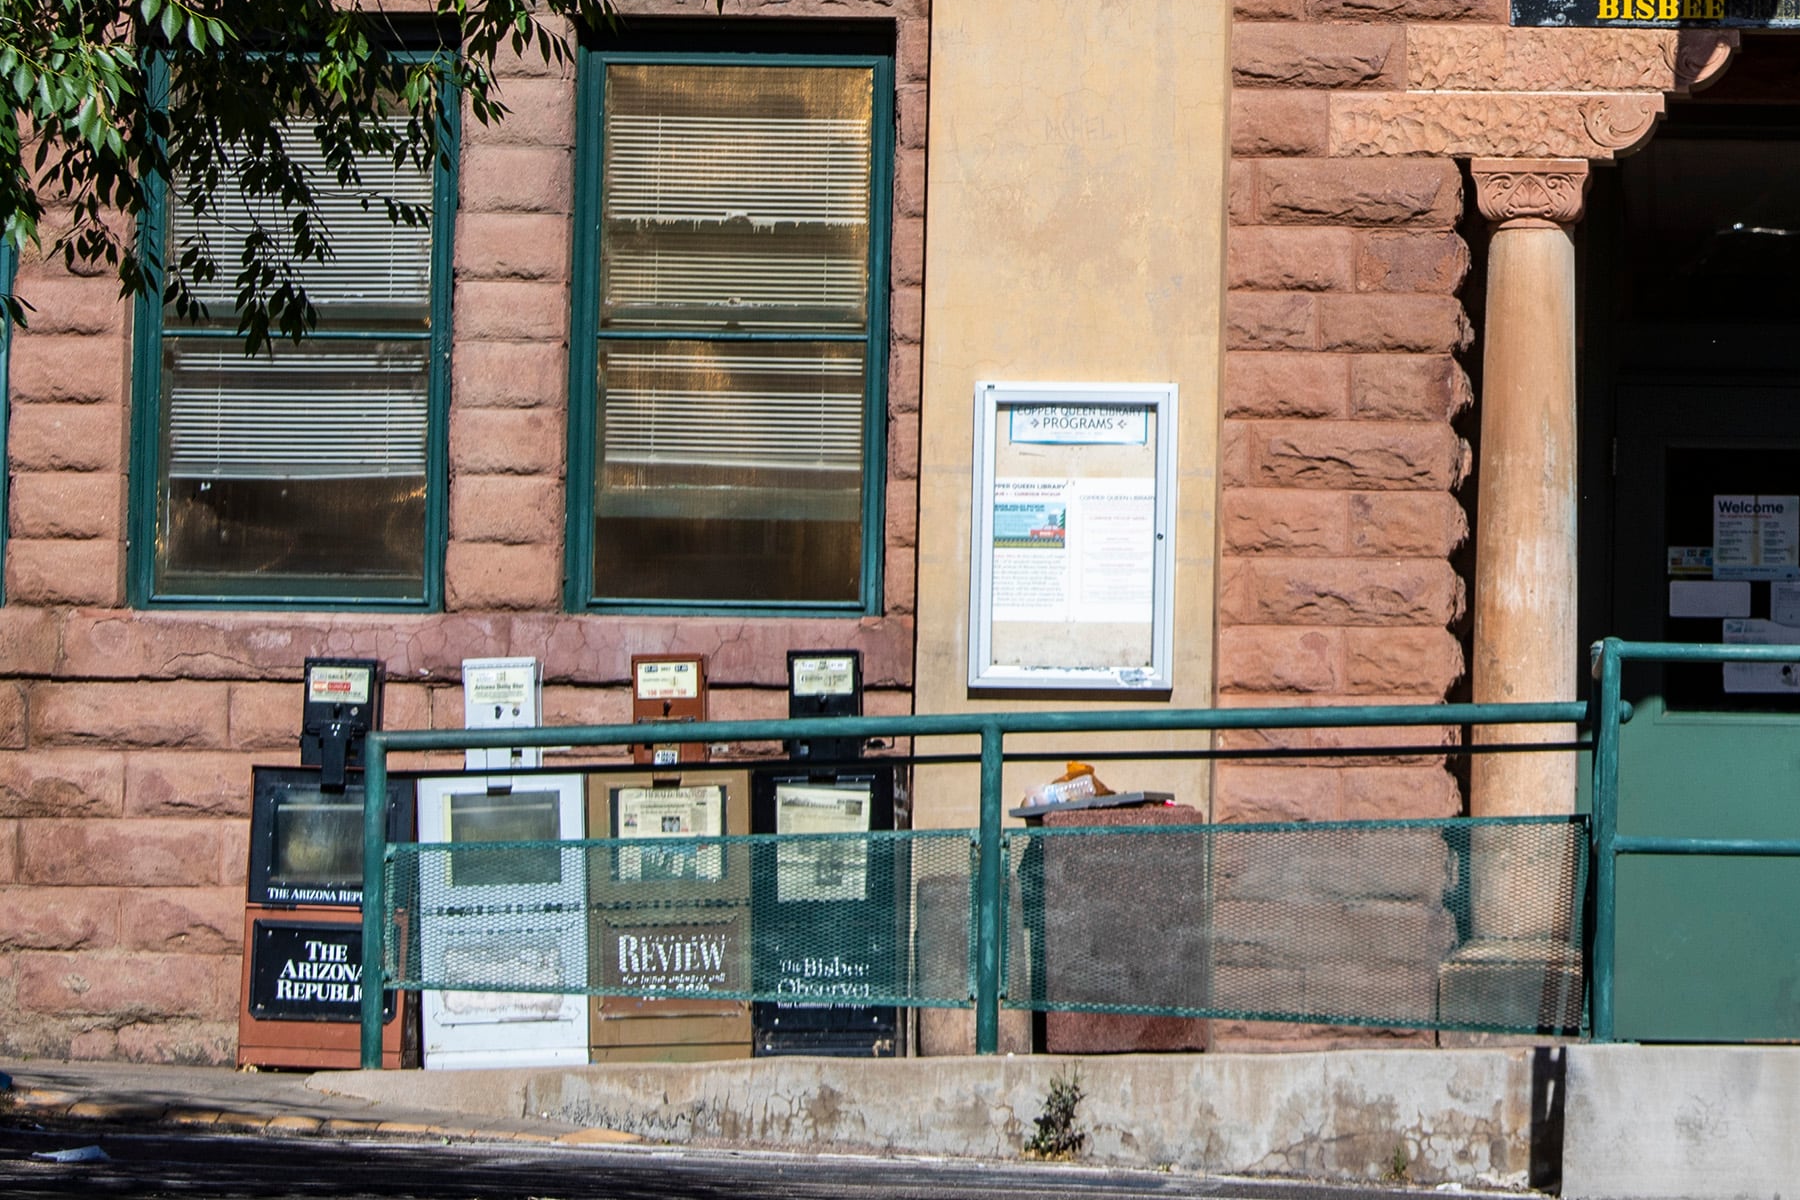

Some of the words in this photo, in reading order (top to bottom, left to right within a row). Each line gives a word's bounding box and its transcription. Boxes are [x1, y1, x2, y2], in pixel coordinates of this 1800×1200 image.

[1016, 406, 1056, 416] COPPER
[1060, 406, 1096, 417] QUEEN
[1100, 407, 1142, 417] LIBRARY
[1043, 417, 1114, 430] PROGRAMS
[1718, 501, 1785, 514] Welcome
[267, 887, 289, 899] THE
[290, 888, 337, 902] ARIZONA
[305, 940, 348, 962] THE
[619, 934, 726, 973] REVIEW
[276, 979, 363, 1003] REPUBLI
